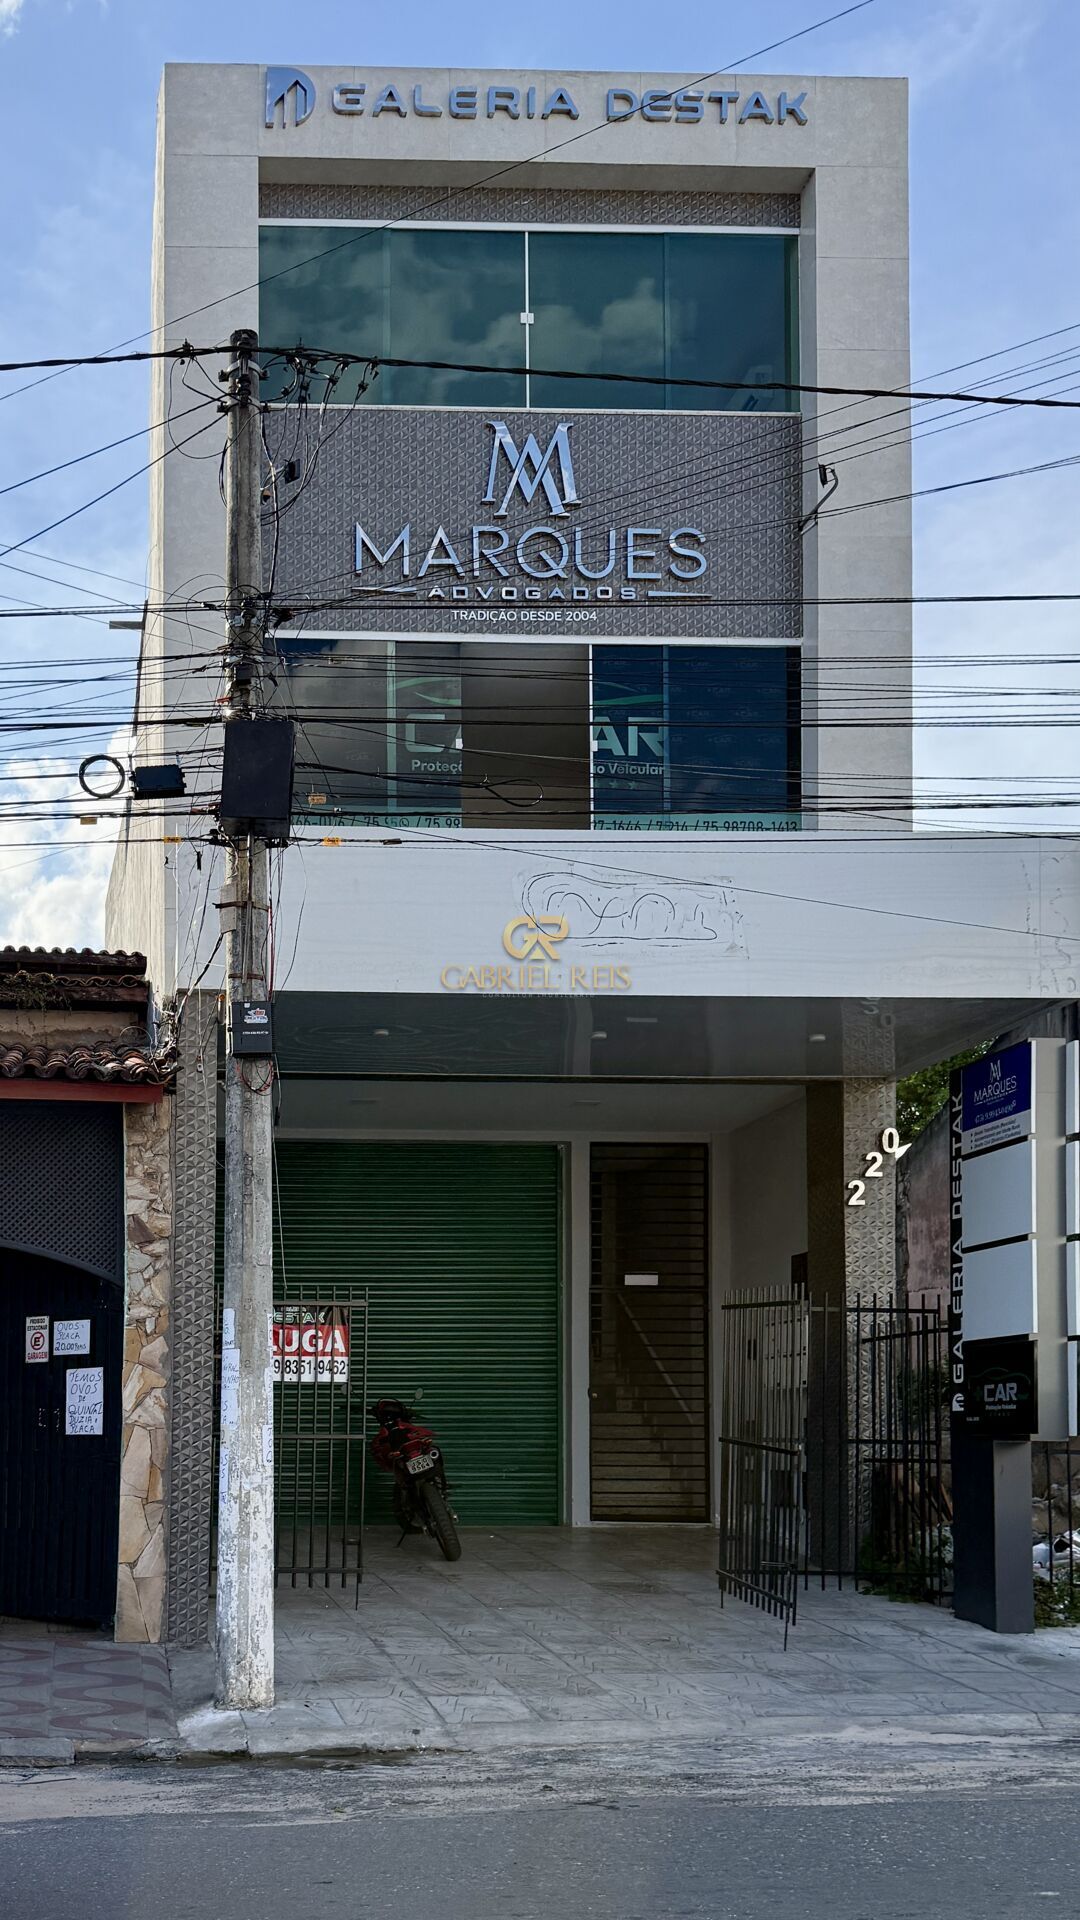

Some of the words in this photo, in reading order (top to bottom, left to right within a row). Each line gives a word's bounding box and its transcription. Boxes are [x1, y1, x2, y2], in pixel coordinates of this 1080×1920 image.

[332, 83, 580, 120] GALERIA
[606, 88, 809, 126] DESTAK
[354, 520, 708, 581] MARQUES
[428, 585, 637, 600] ADVOGADOS
[451, 608, 518, 624] TRADIÇÃO
[520, 610, 563, 622] DESDE
[566, 610, 598, 622] 2004
[609, 763, 666, 776] Veicular
[440, 965, 560, 990] GABRIEL
[571, 966, 633, 990] REIS
[973, 1074, 1017, 1104] MARQUES
[847, 1127, 900, 1206] 220
[951, 1091, 963, 1219] DESTAK
[952, 1235, 964, 1384] GALERIA
[69, 1370, 102, 1382] TEMOS
[71, 1383, 98, 1395] OVOS
